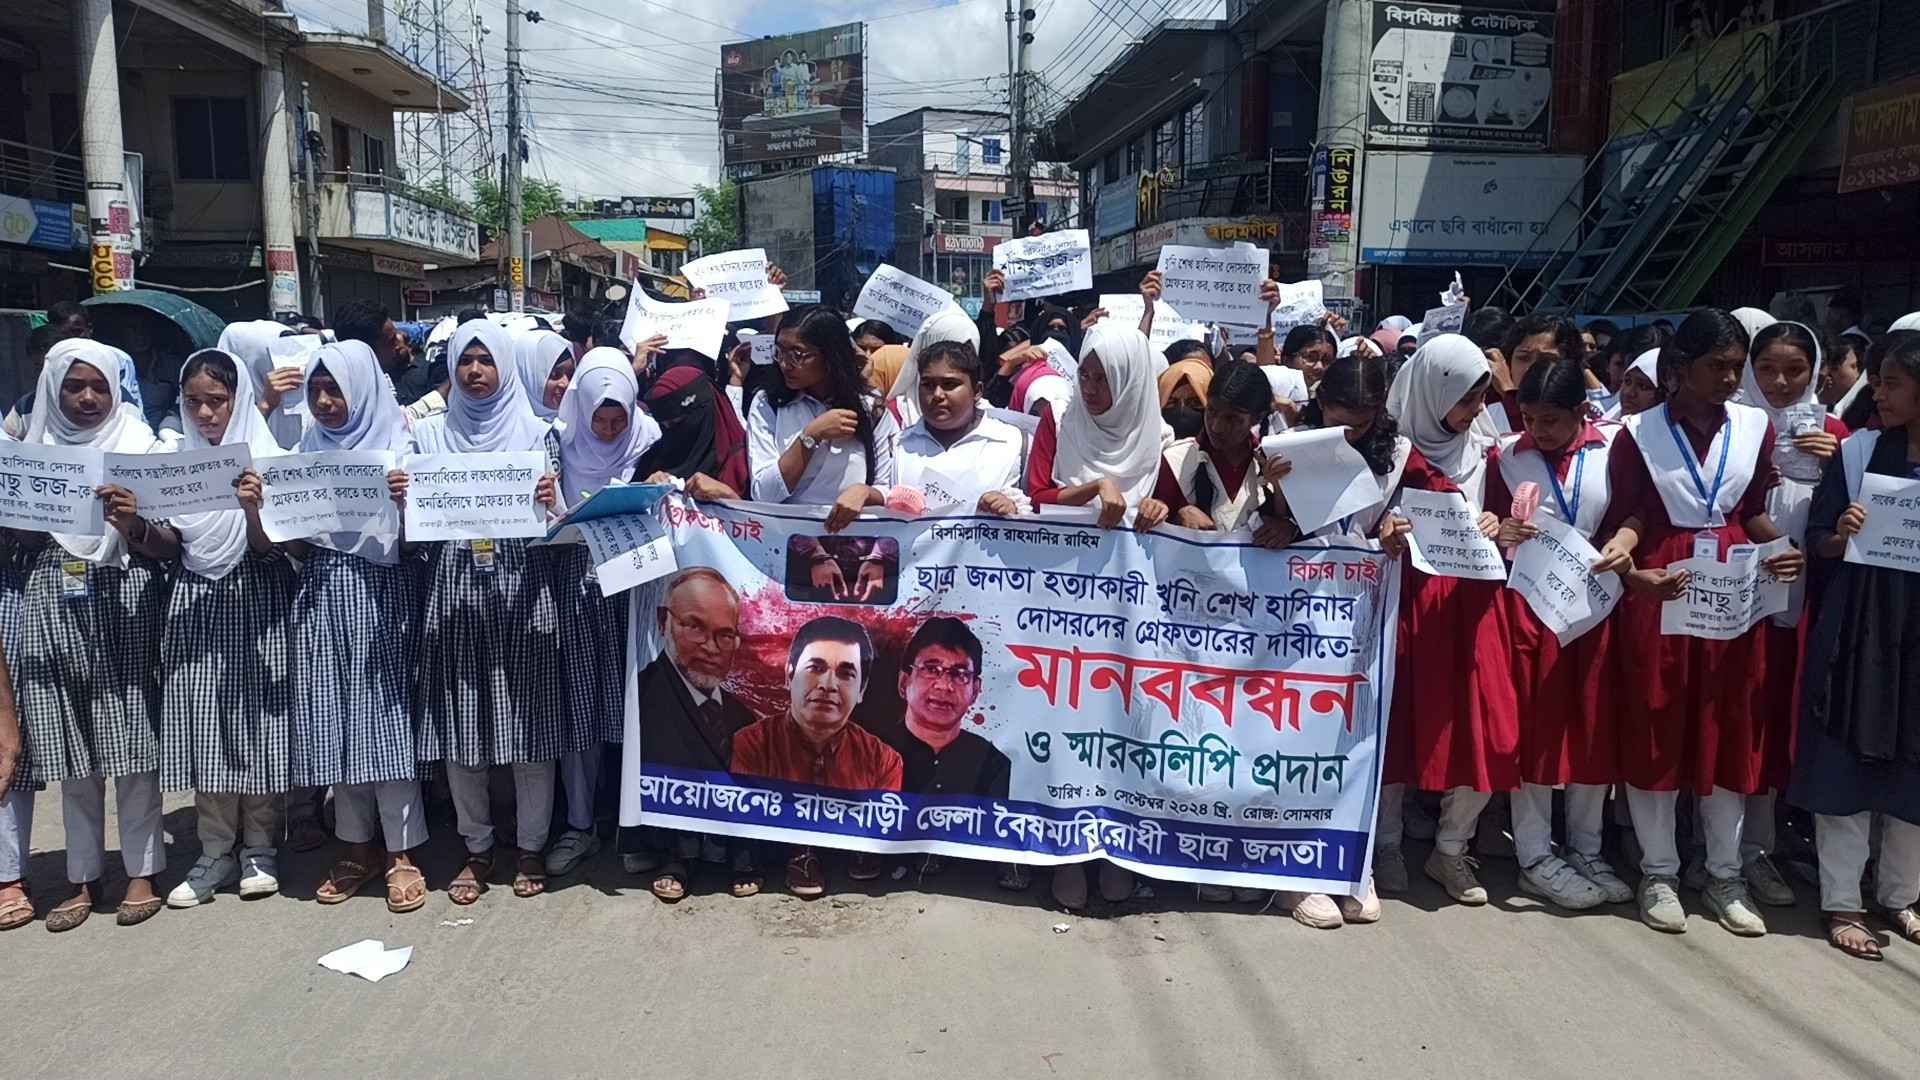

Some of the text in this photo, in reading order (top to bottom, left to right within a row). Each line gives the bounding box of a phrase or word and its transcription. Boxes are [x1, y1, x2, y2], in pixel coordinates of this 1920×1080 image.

[1329, 149, 1353, 213] নিউরন
[1389, 217, 1436, 235] এখানে
[1440, 215, 1465, 235] ছবি
[50, 462, 85, 474] দোসর
[282, 468, 302, 481] শেখ
[305, 461, 340, 479] হাসিনার
[343, 465, 384, 479] দোসরদের
[413, 466, 467, 485] মানবাধিকার
[271, 490, 309, 506] গ্রেফতার
[333, 487, 358, 499] করতে
[416, 492, 471, 510] অনতিবিলম্বে
[475, 495, 513, 508] গ্রেফতার
[730, 517, 764, 544] চাই
[931, 524, 1101, 550] বিসমিল্লাহির রাহমানির রাহিম
[1287, 556, 1378, 585] বিচার চাই
[916, 564, 1357, 622] ছাত্র জনতা হত্যাকারী খুনি শেখ হাসিনার
[1017, 606, 1127, 642] দোসরদের
[1136, 618, 1258, 658] গ্রেফতারের
[1005, 643, 1370, 734] মানববন্ধন
[1025, 728, 1349, 796] ও স্মারকলিপি প্রদান
[1095, 784, 1106, 797] ৯
[1114, 788, 1165, 811] সেপ্টেম্বর
[1169, 801, 1208, 817] ২০২৪
[1283, 808, 1333, 821] সোমবার
[793, 792, 909, 834] রাজবাড়ী
[917, 804, 985, 836] জেলা
[992, 801, 1169, 855] বৈষম্যবিরোধী
[1177, 832, 1233, 861] ছাত্র
[1241, 838, 1328, 868] জনতা
